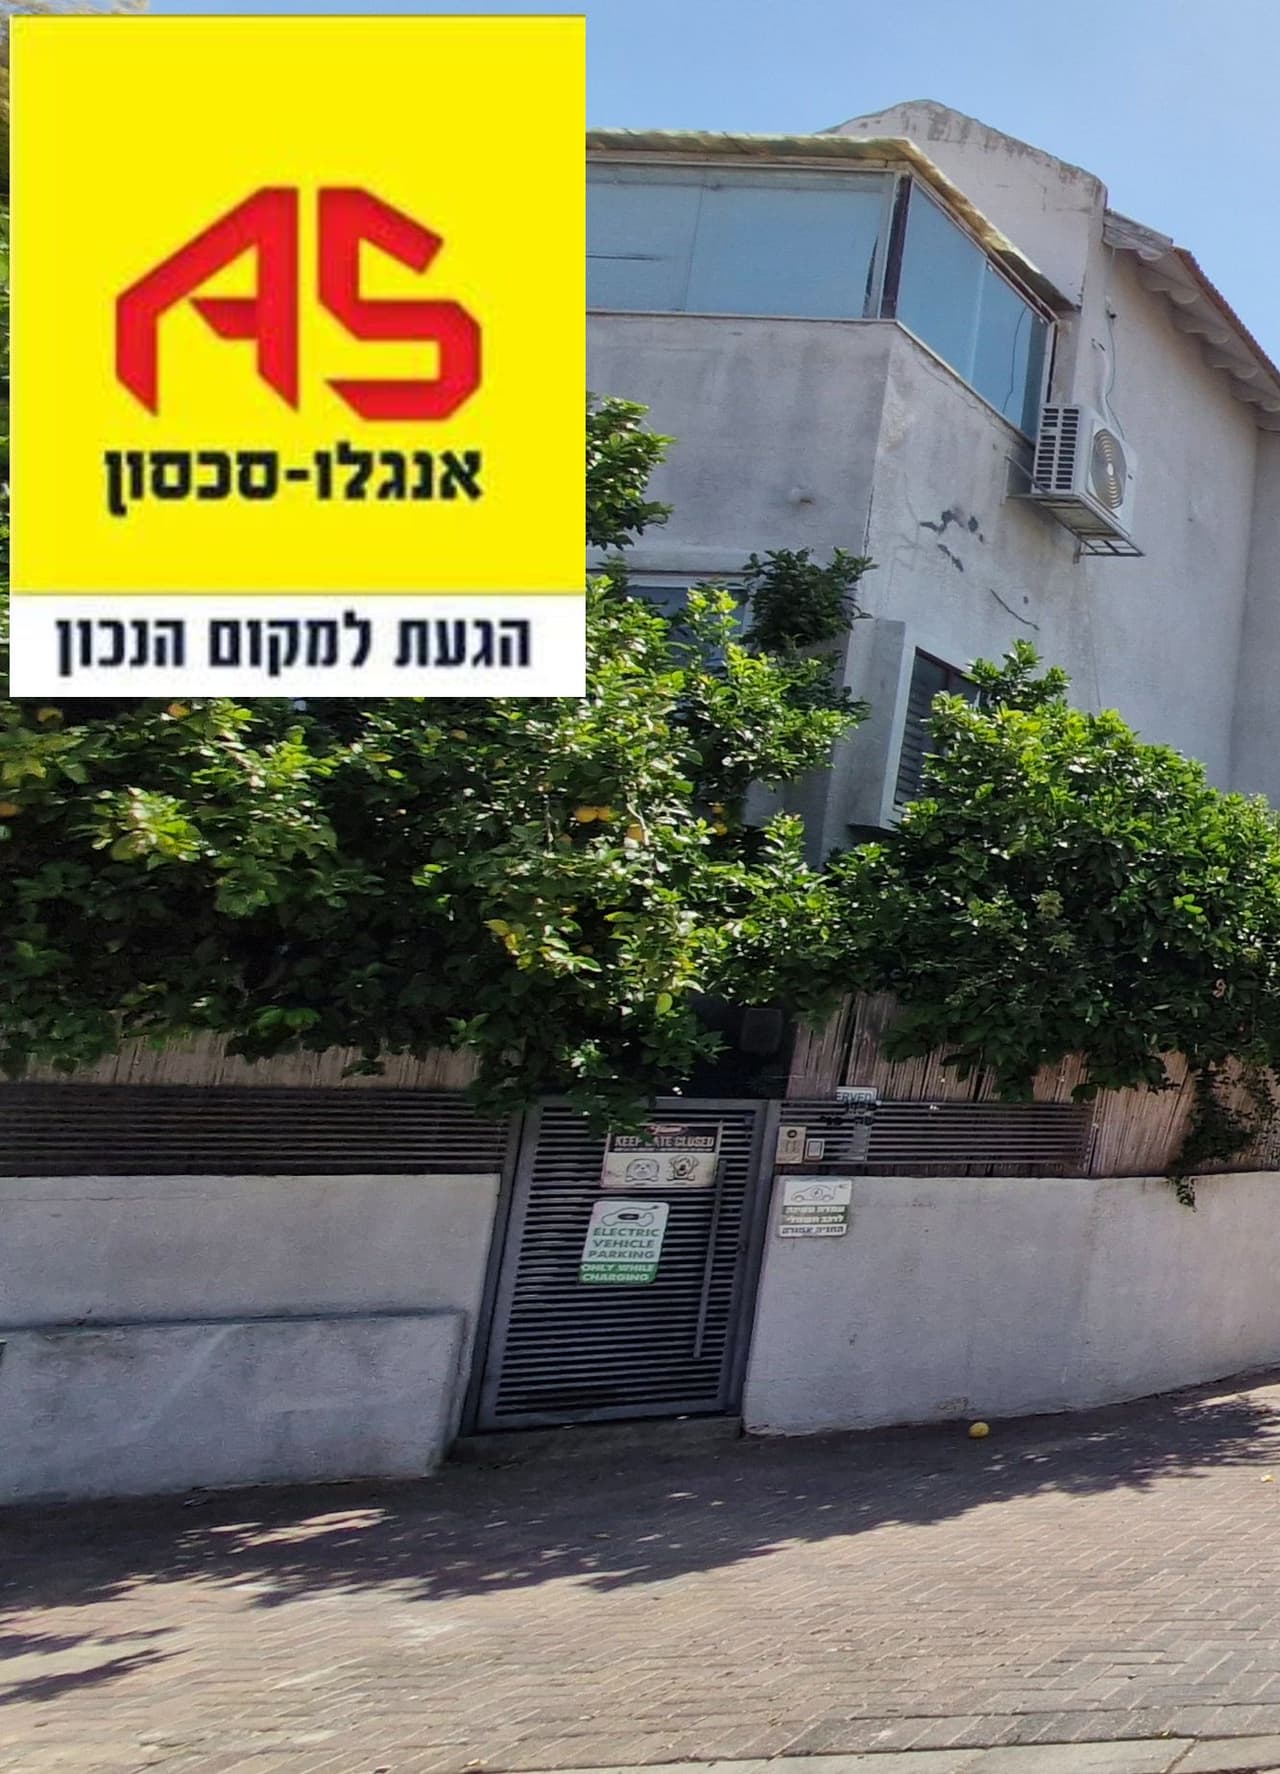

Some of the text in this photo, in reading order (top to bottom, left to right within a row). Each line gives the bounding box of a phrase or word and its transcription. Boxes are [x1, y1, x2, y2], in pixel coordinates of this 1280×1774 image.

[674, 1135, 715, 1148] CLOSED
[593, 1227, 661, 1237] ELECTRIC
[592, 1239, 656, 1248] VEHICLE
[588, 1250, 655, 1259] PARKING
[581, 1263, 656, 1272] ONLY WHILE
[582, 1273, 650, 1282] CHARGING
